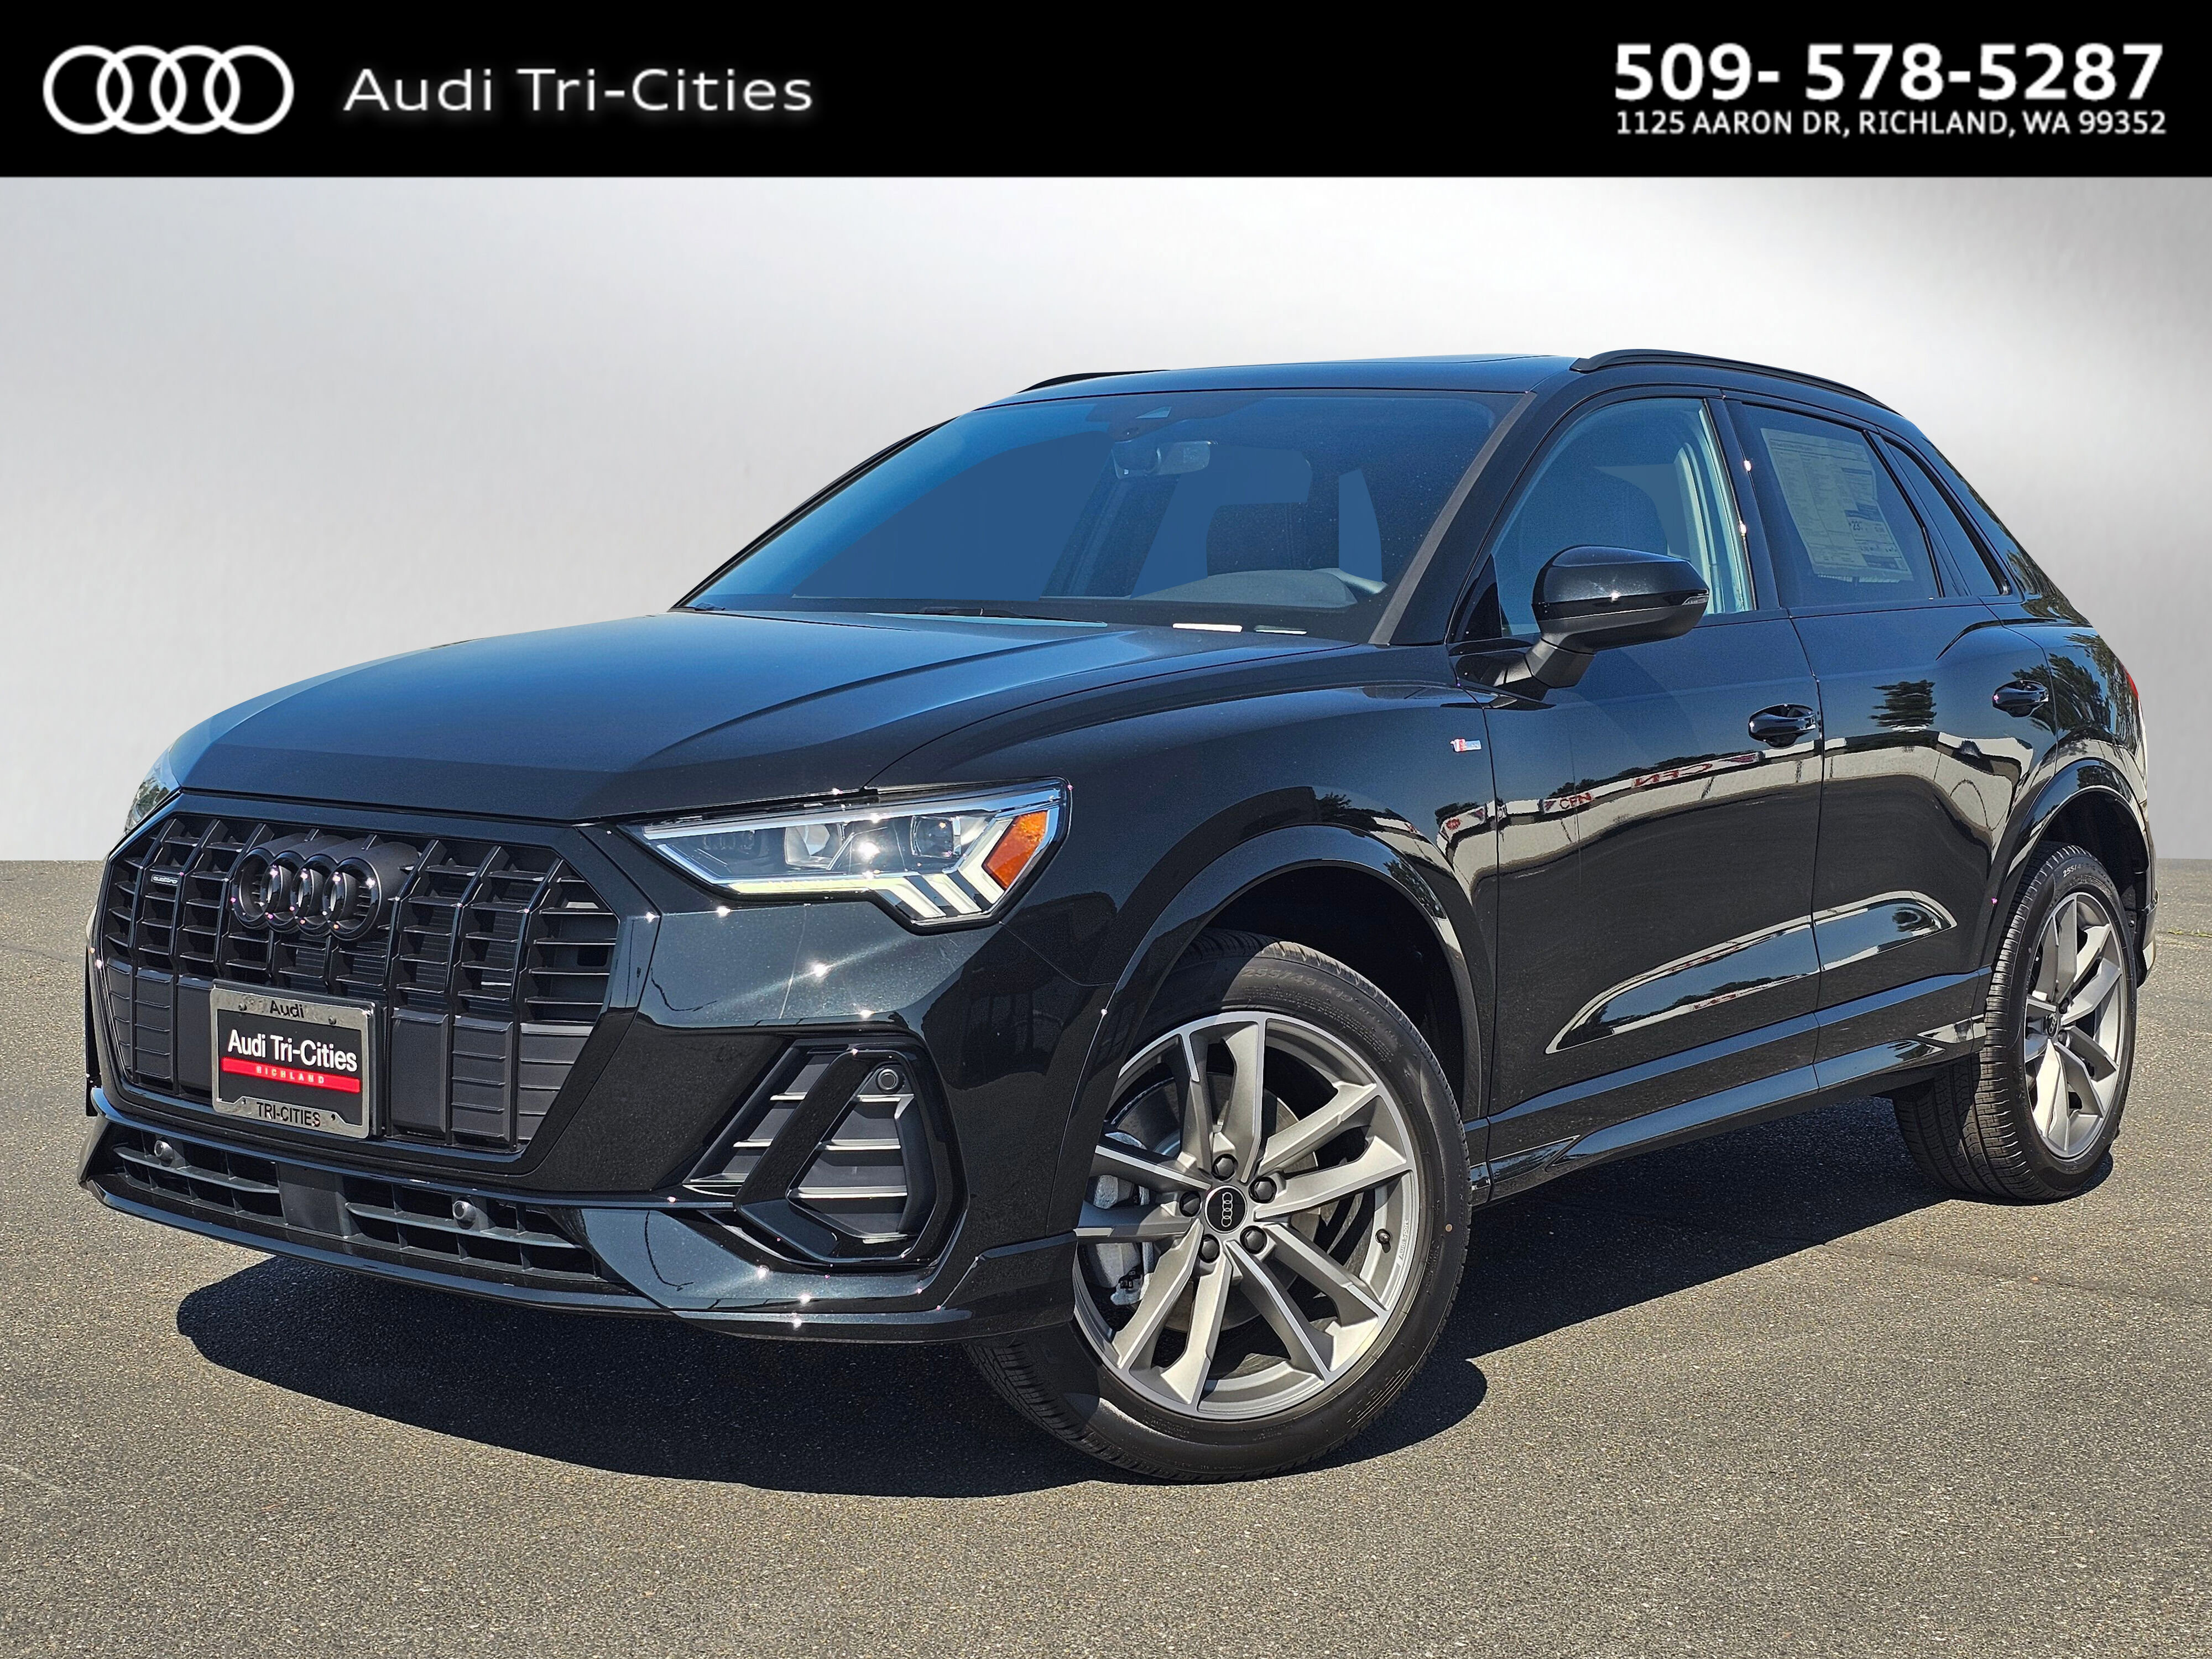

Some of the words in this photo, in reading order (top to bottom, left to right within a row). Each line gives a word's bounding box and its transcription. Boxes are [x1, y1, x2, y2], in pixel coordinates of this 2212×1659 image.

[269, 1000, 305, 1019] Audi
[228, 1029, 266, 1058] Audi
[270, 1035, 358, 1072] Tri-Cities
[255, 1065, 325, 1084] RICHLAND
[256, 1102, 321, 1128] TRI-CITIES
